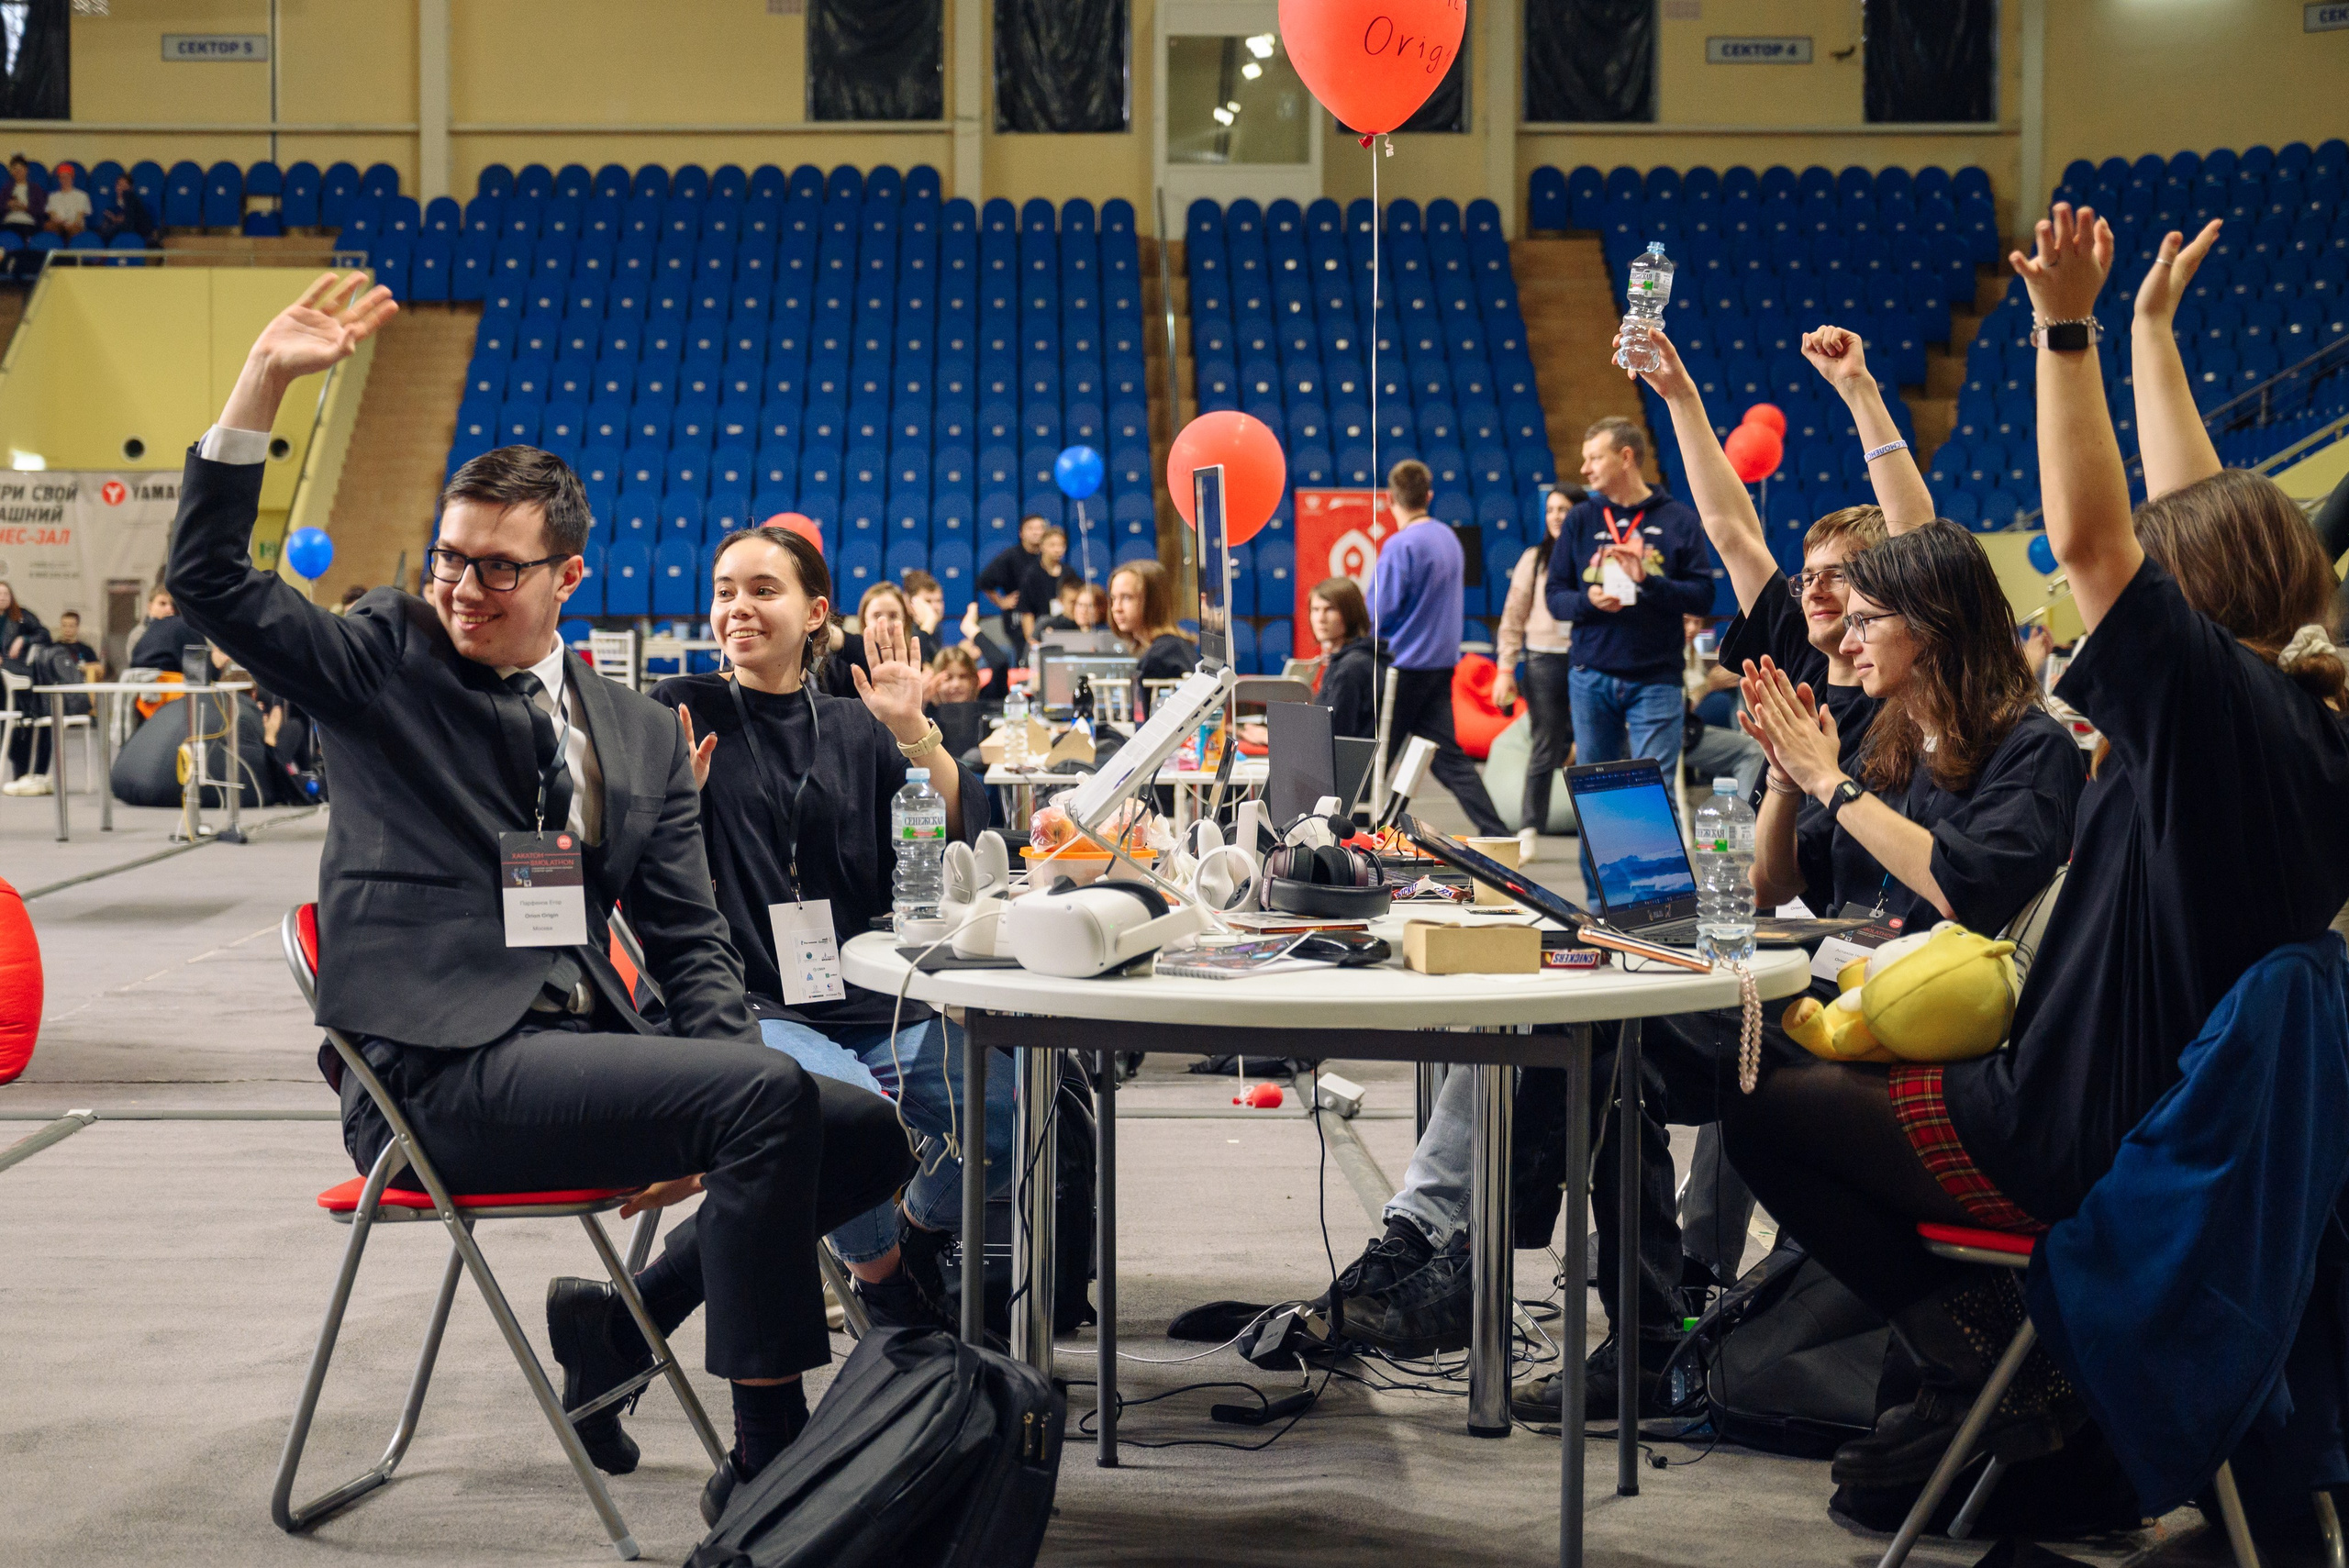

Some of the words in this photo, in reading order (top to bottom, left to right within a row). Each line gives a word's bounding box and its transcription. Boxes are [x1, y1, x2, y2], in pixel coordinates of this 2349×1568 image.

[178, 41, 239, 54] СЕКТОР
[1722, 44, 1783, 57] СЕКТОР
[32, 481, 79, 502] СВОЙ
[904, 817, 944, 826] СЕНЕЖСКАЯ
[1553, 953, 1596, 964] SNICKERS
